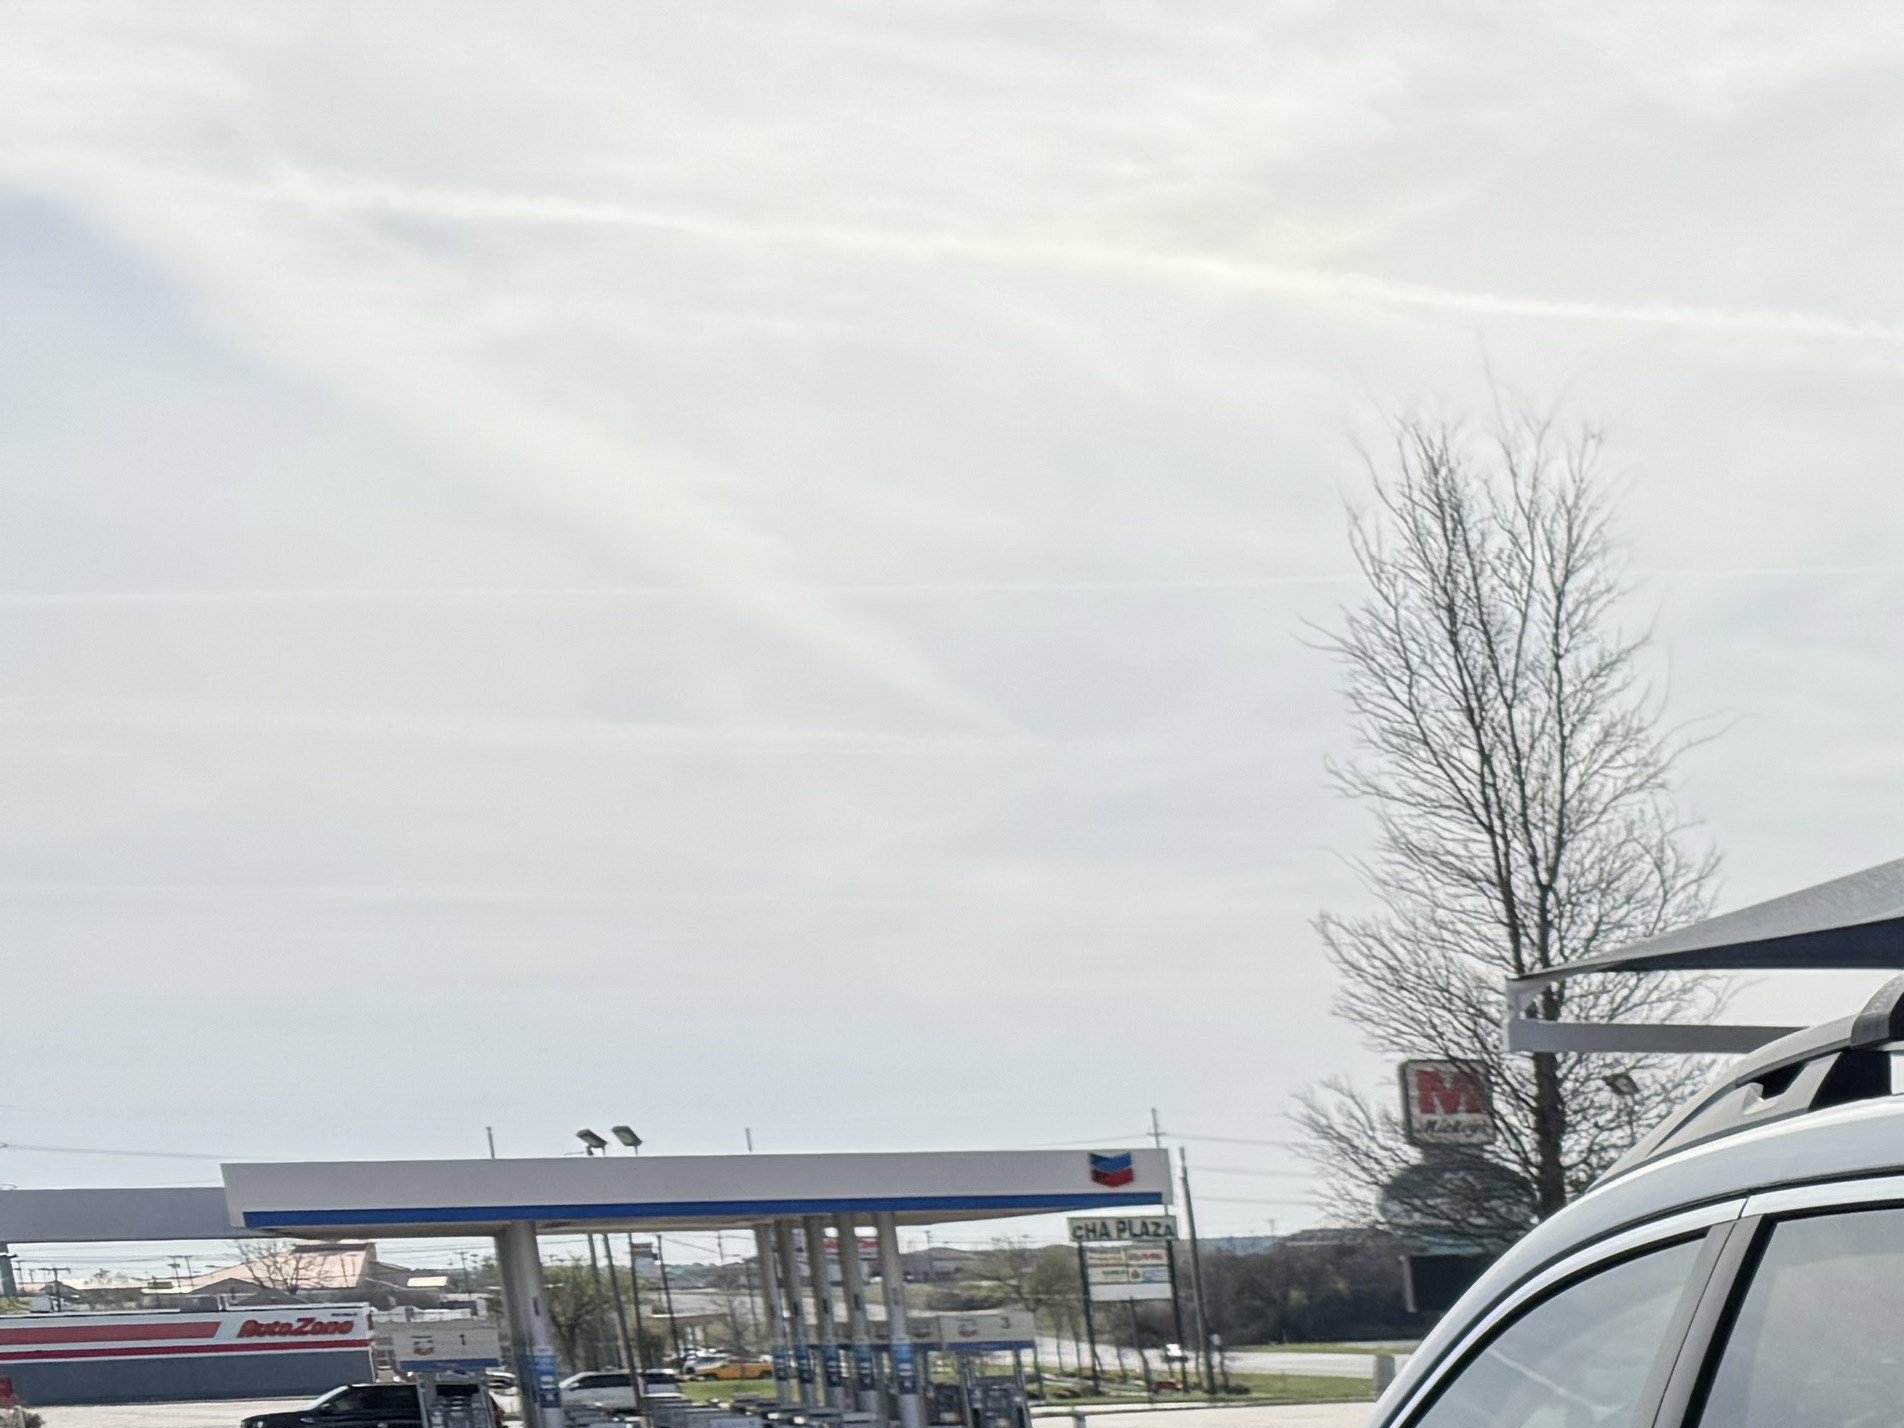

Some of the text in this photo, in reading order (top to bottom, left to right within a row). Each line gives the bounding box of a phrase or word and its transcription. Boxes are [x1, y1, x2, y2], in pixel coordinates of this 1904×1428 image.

[1415, 1070, 1486, 1114] M
[1117, 1219, 1175, 1238] PLAZA
[237, 1317, 354, 1338] AutoZone
